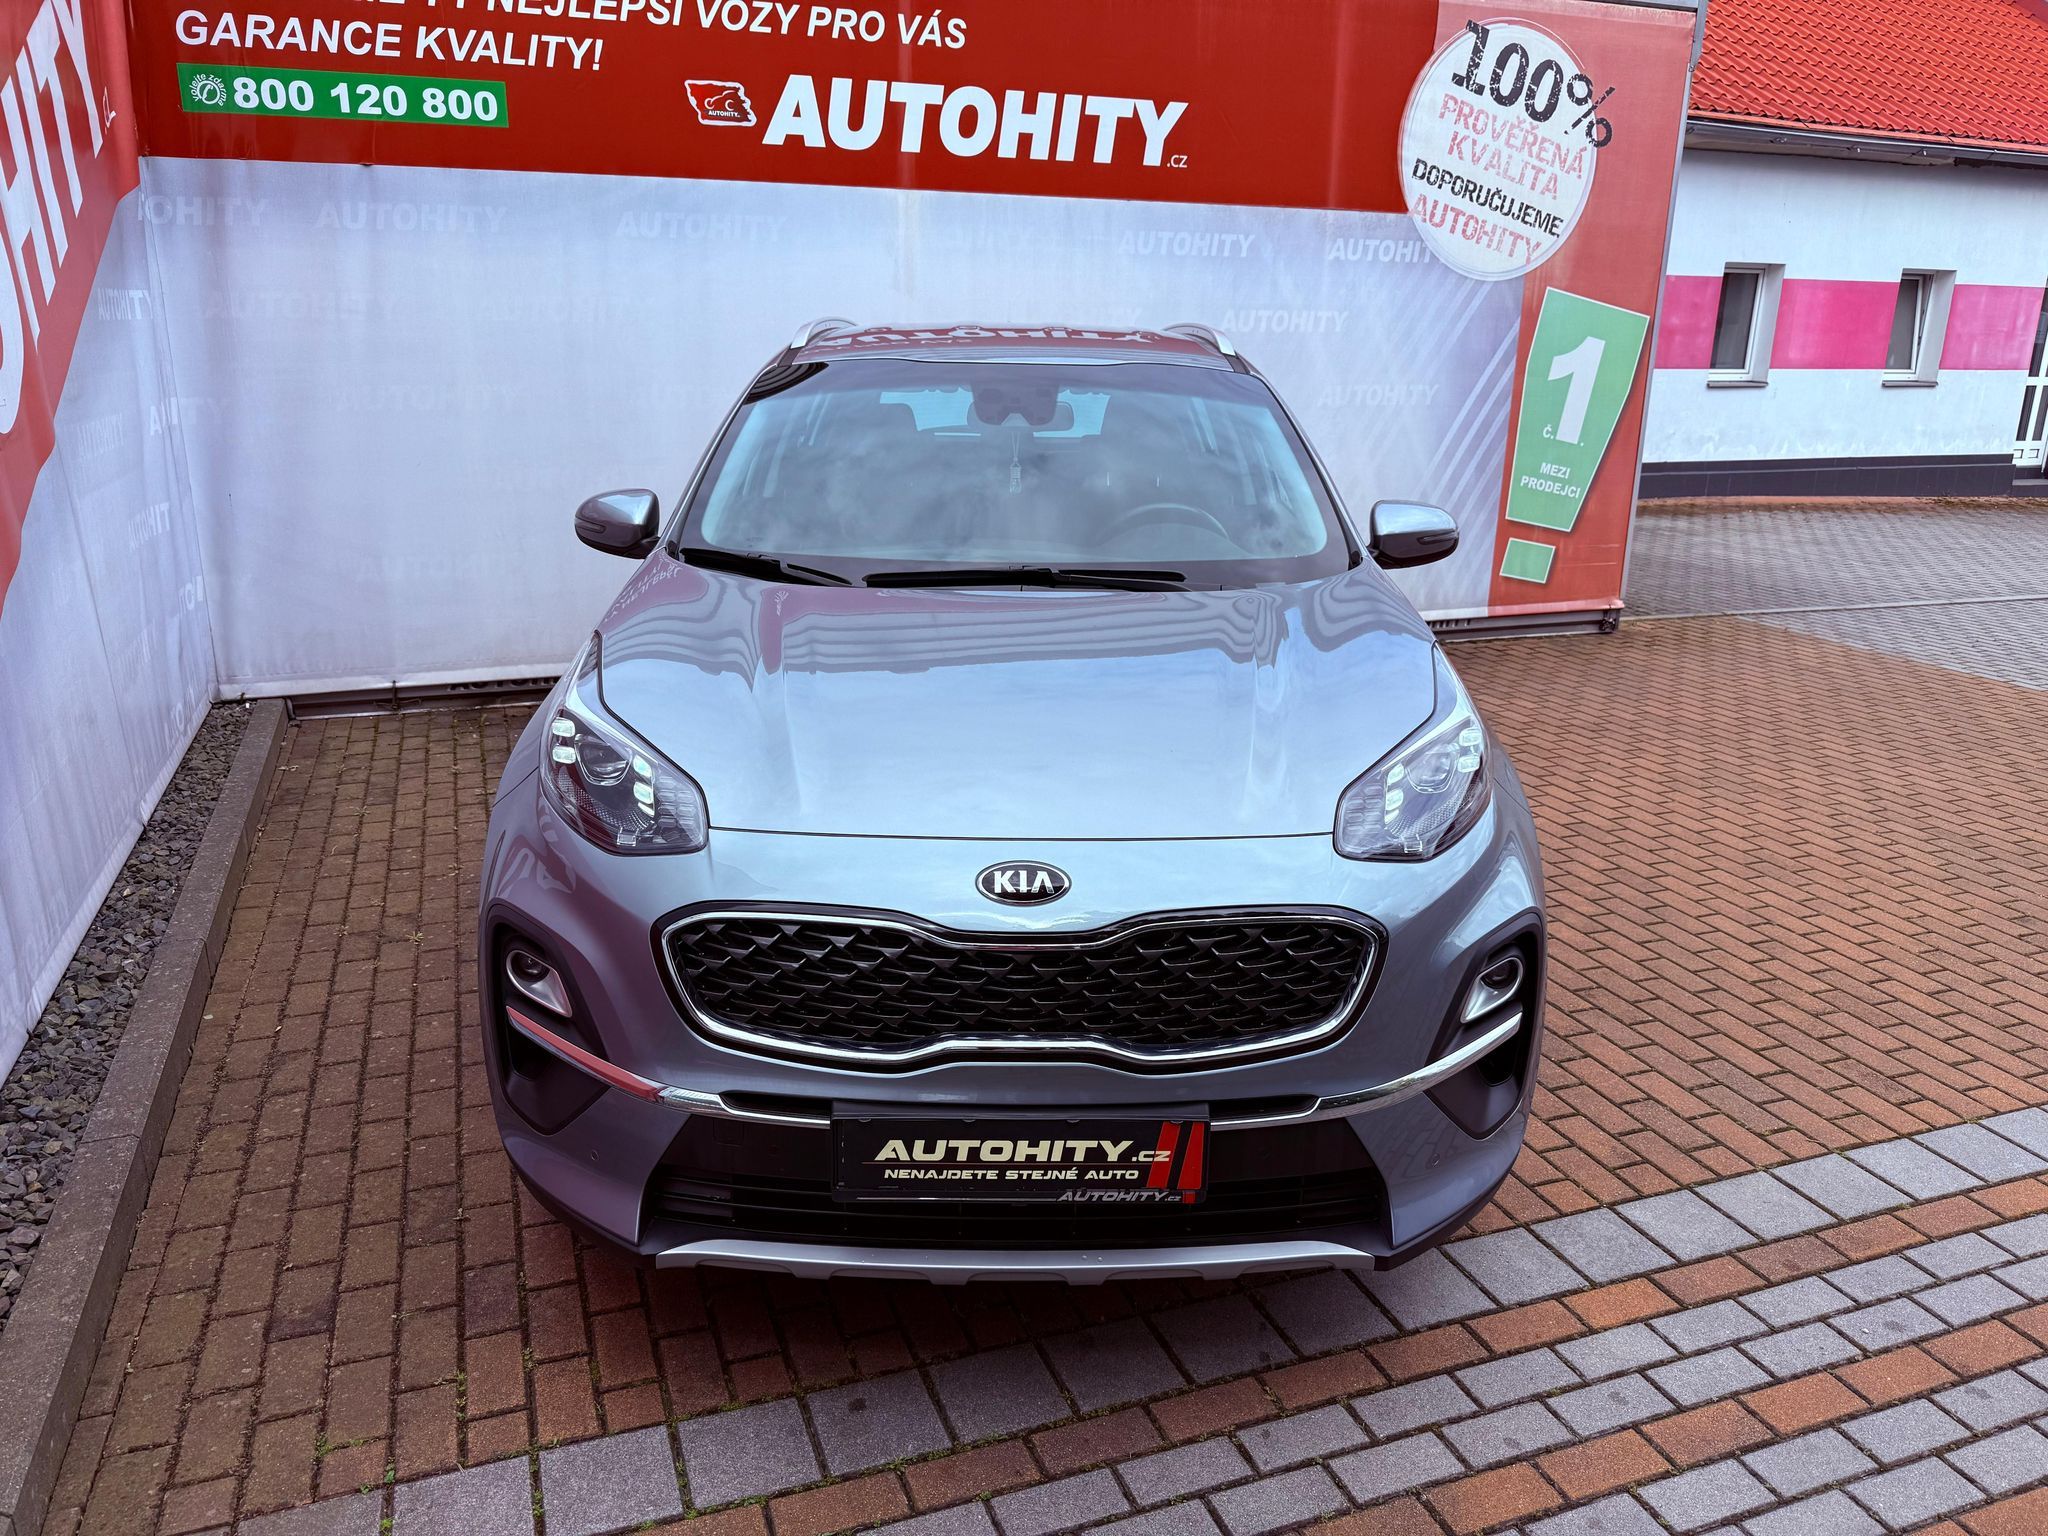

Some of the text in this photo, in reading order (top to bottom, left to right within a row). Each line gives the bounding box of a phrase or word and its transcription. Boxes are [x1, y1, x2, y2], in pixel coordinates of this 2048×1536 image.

[175, 9, 603, 71] GARANCE KVALITY!
[696, 0, 800, 36] VOZY
[807, 6, 886, 42] PRO
[898, 9, 967, 49] VÁS
[189, 73, 227, 106] volejte zdarma
[232, 77, 498, 122] 800 120 800
[1451, 19, 1616, 149] 100%
[1438, 92, 1588, 180] PROVĚŘENÁ
[1447, 130, 1559, 201] KVALITA
[1411, 157, 1564, 239] DOPORUČUJEME
[315, 201, 508, 233] AUTOHITY
[614, 210, 788, 242] AUTOHITY
[1117, 230, 1256, 258] AUTOHITY
[1407, 193, 1543, 267] AUTOHITY
[1220, 309, 1349, 334] AUTOHITY
[1316, 384, 1440, 408] AUTOHITY
[1520, 475, 1581, 499] PRODEJCI
[1540, 462, 1571, 479] MEZI
[993, 870, 1055, 894] KIA
[884, 1166, 1140, 1180] NENAJDETE STEJNÉ AUTO
